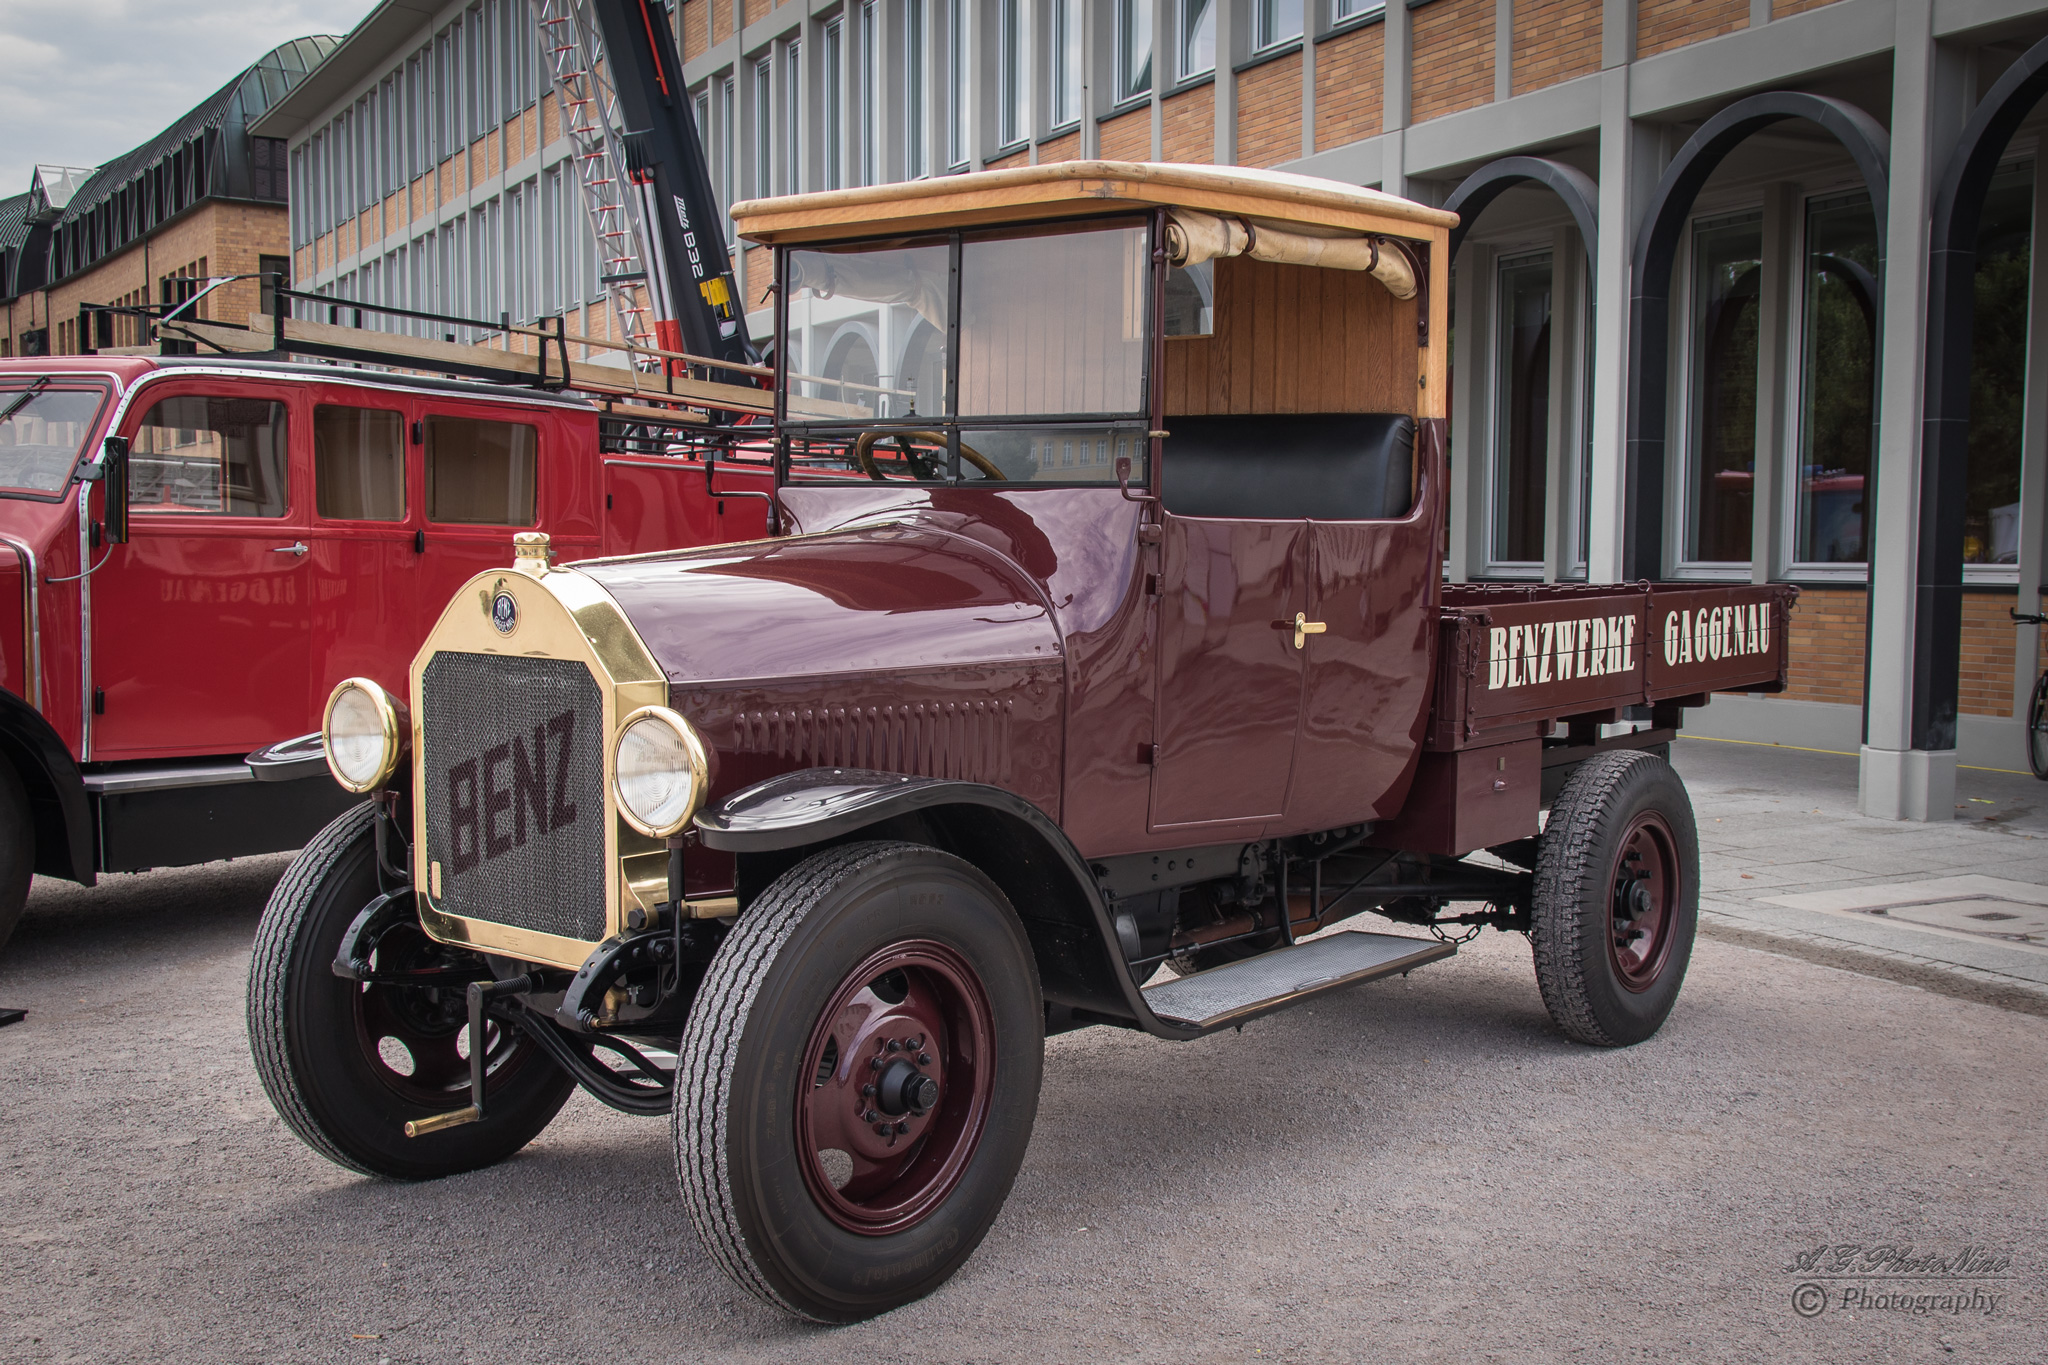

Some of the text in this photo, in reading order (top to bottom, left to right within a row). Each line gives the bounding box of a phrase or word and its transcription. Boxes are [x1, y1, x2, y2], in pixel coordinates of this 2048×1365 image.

[683, 231, 704, 279] B32
[1488, 602, 1771, 690] BENZWERKE GAGGENAU
[450, 708, 577, 876] BENZ
